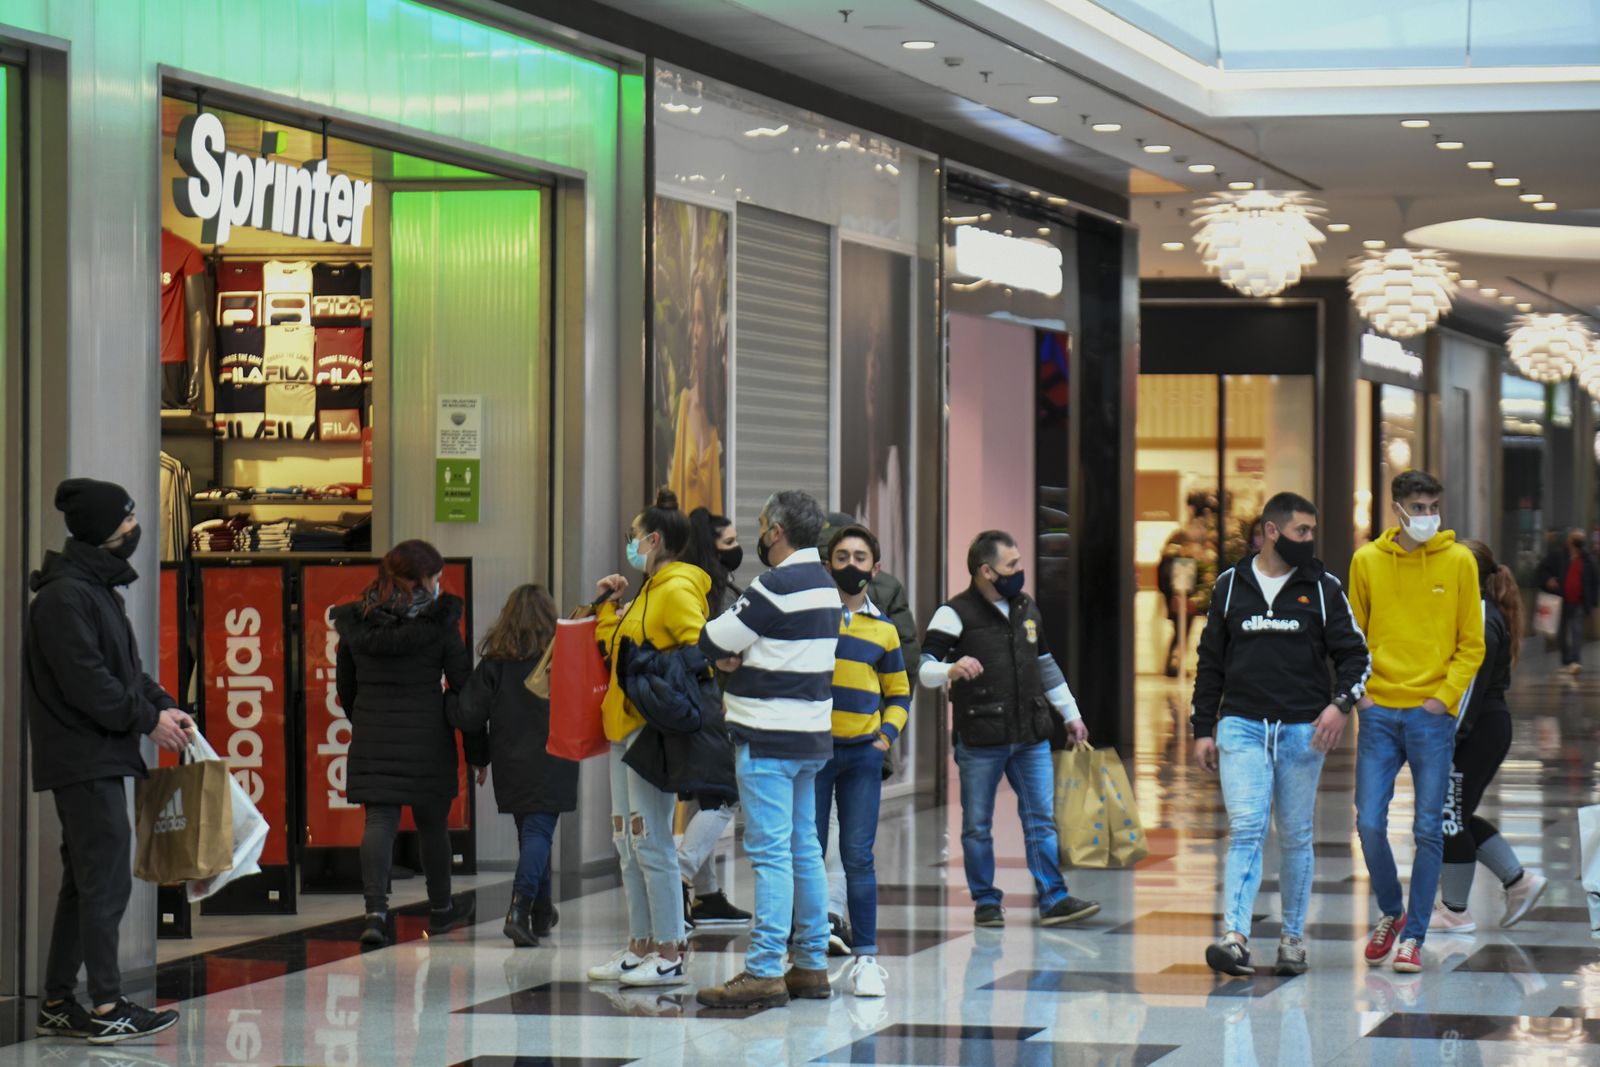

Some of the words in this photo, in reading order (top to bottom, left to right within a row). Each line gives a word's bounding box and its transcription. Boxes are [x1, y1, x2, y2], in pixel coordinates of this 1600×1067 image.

[187, 112, 373, 247] Sprinter
[219, 366, 264, 384] FILA
[265, 365, 309, 381] FILA
[316, 367, 362, 385] FILA
[322, 421, 358, 436] FILA
[1241, 615, 1300, 632] ellesse
[216, 605, 274, 806] ebajas
[153, 817, 187, 834] adidas
